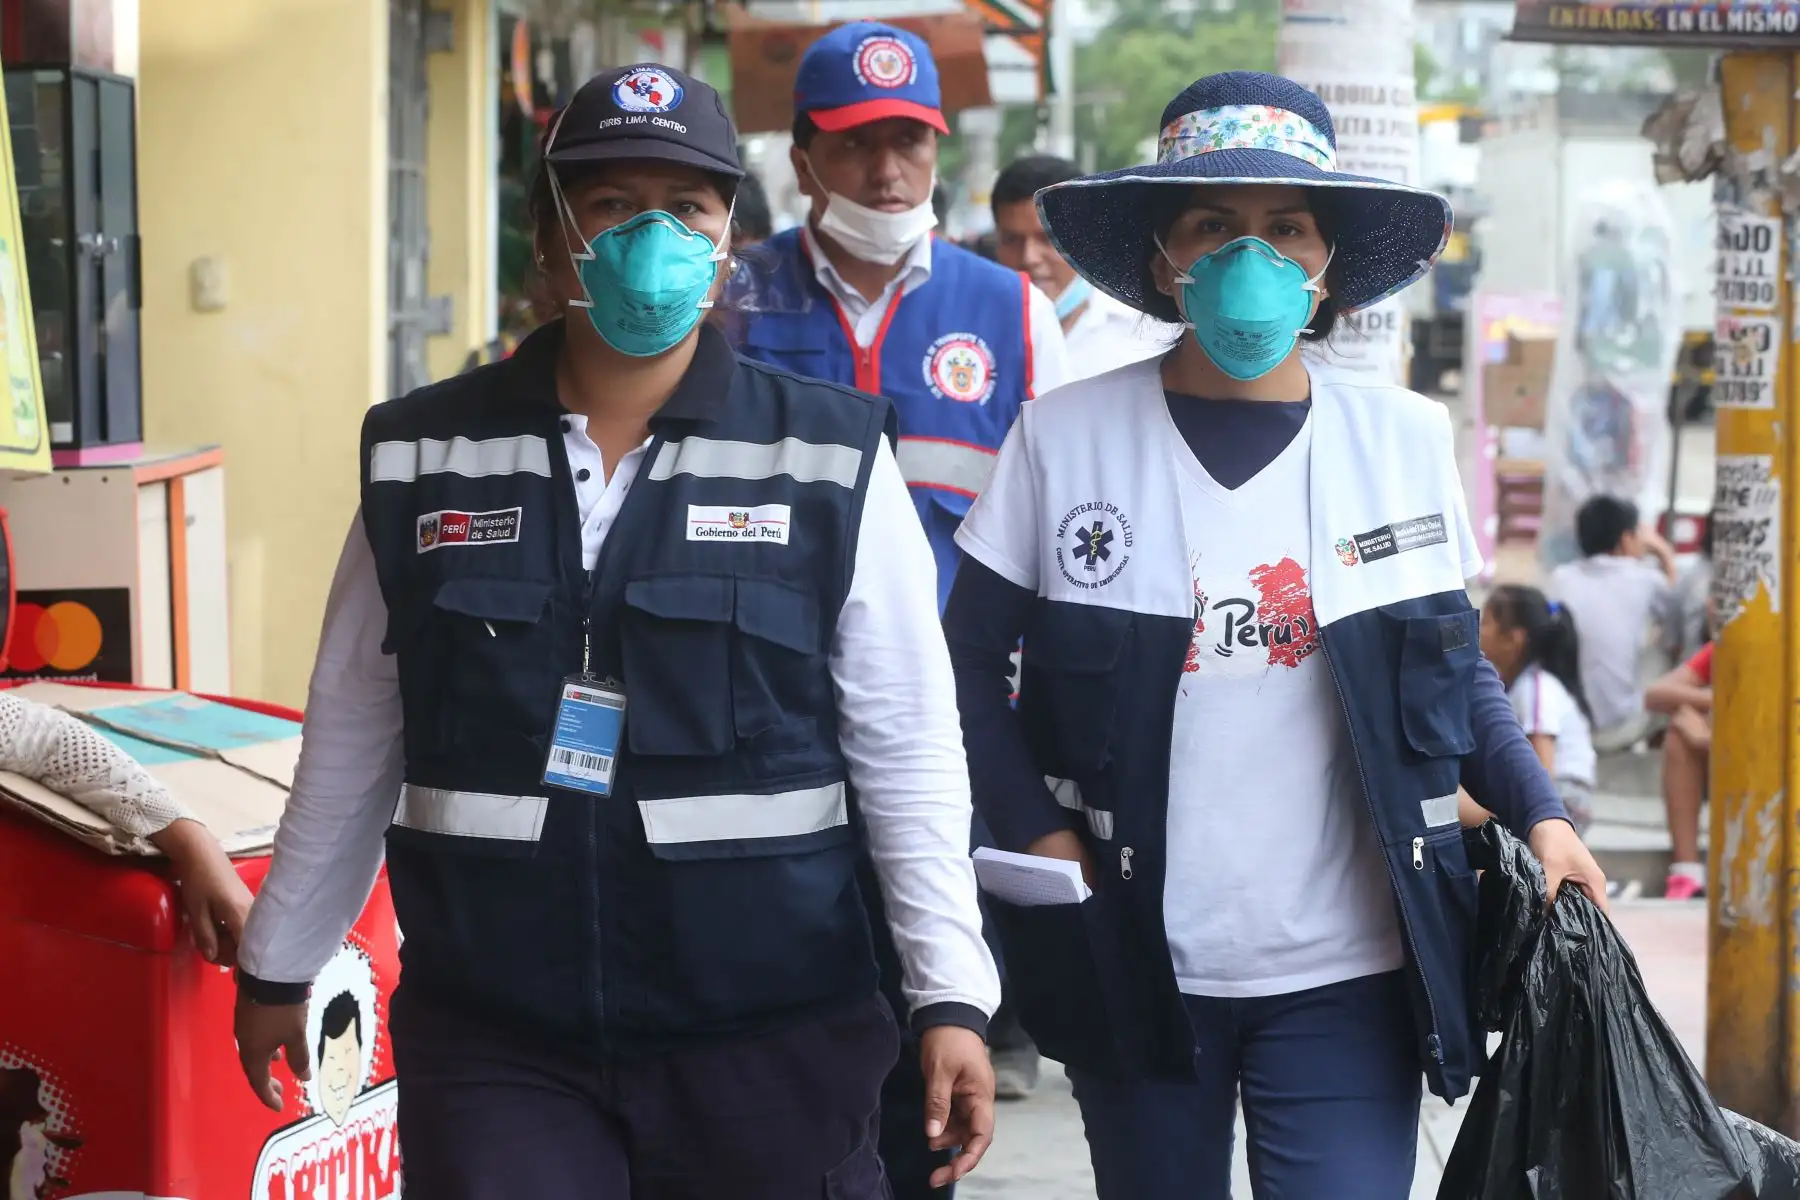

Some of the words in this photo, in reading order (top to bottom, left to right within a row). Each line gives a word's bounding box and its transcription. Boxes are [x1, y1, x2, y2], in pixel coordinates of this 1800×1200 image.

[1549, 6, 1662, 31] ENTRADAS:
[1667, 11, 1694, 32] EN
[1698, 12, 1722, 32] EL
[1727, 11, 1798, 33] MISMO
[599, 117, 623, 129] DIRIS
[625, 115, 648, 125] LIMA
[651, 116, 687, 134] CENTRO
[442, 521, 466, 535] PERÚ
[472, 515, 516, 528] Ministerio
[1056, 501, 1103, 539] MINISTERIO
[1104, 502, 1119, 516] DE
[1116, 513, 1134, 548] SALUD
[471, 530, 483, 540] de
[486, 527, 511, 539] Salud
[695, 526, 738, 538] Gobierno
[741, 527, 757, 538] del
[760, 526, 782, 539] Perú
[1358, 533, 1392, 548] MINISTERIO
[1363, 546, 1373, 555] DE
[1372, 541, 1392, 553] SALUD
[1062, 570, 1090, 590] OPERATIVO
[1090, 582, 1098, 590] DE
[1099, 555, 1130, 587] EMERGENCIAS
[1211, 597, 1293, 648] Perú
